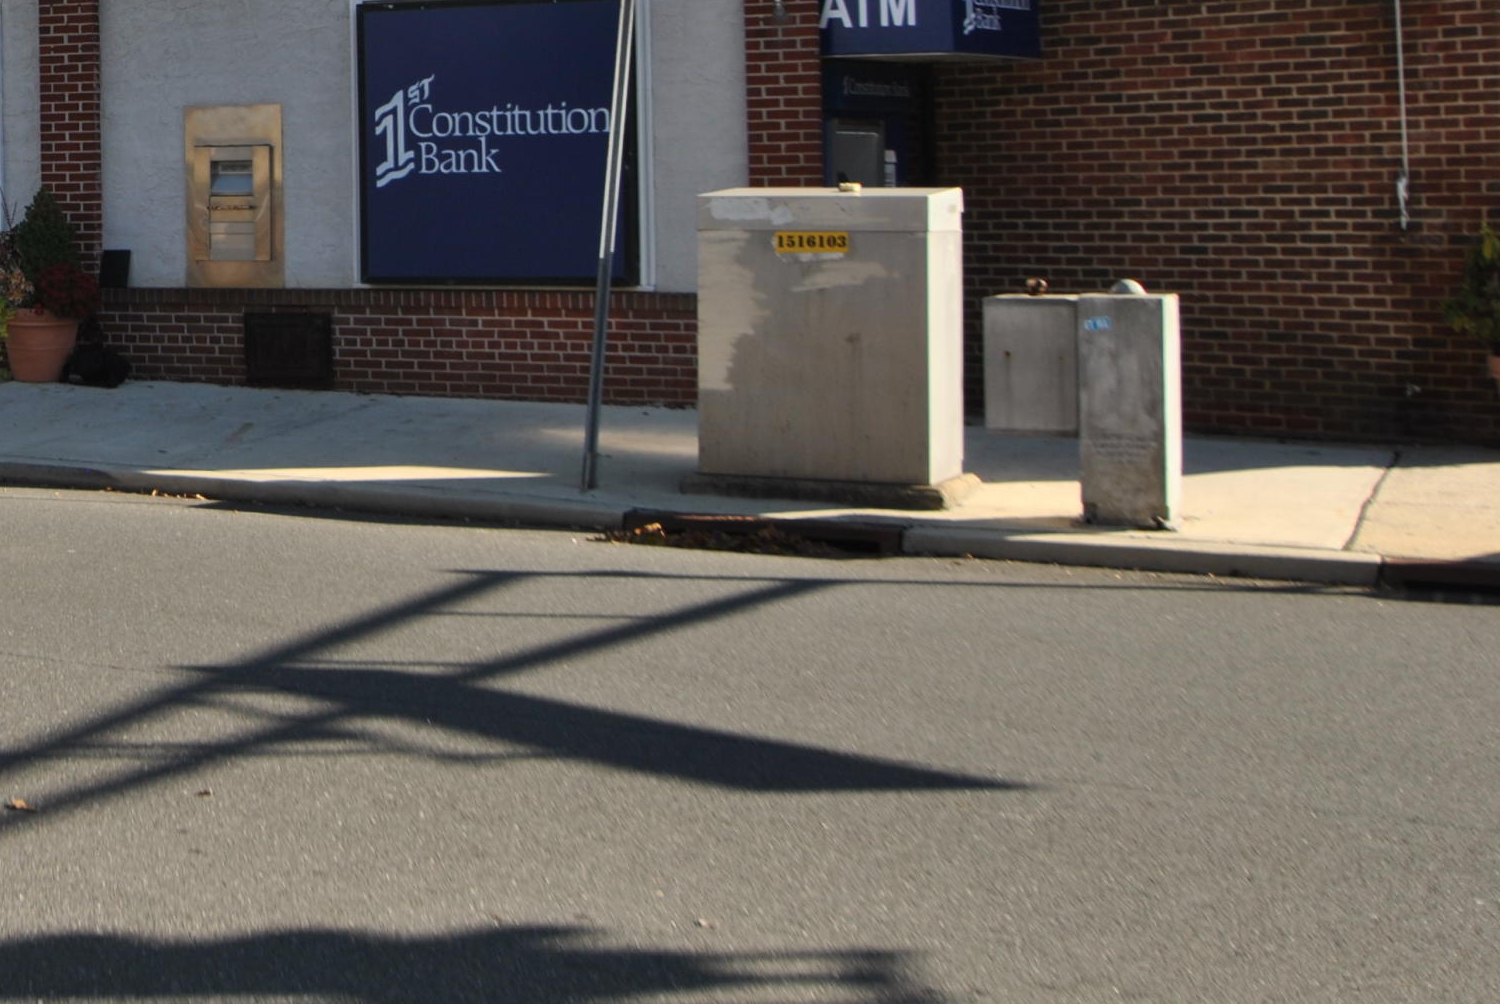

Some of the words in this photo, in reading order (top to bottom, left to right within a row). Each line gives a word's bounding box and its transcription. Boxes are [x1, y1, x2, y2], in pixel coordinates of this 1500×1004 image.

[409, 101, 612, 138] Constitution
[418, 135, 502, 174] Bank
[777, 234, 847, 249] 1516103
